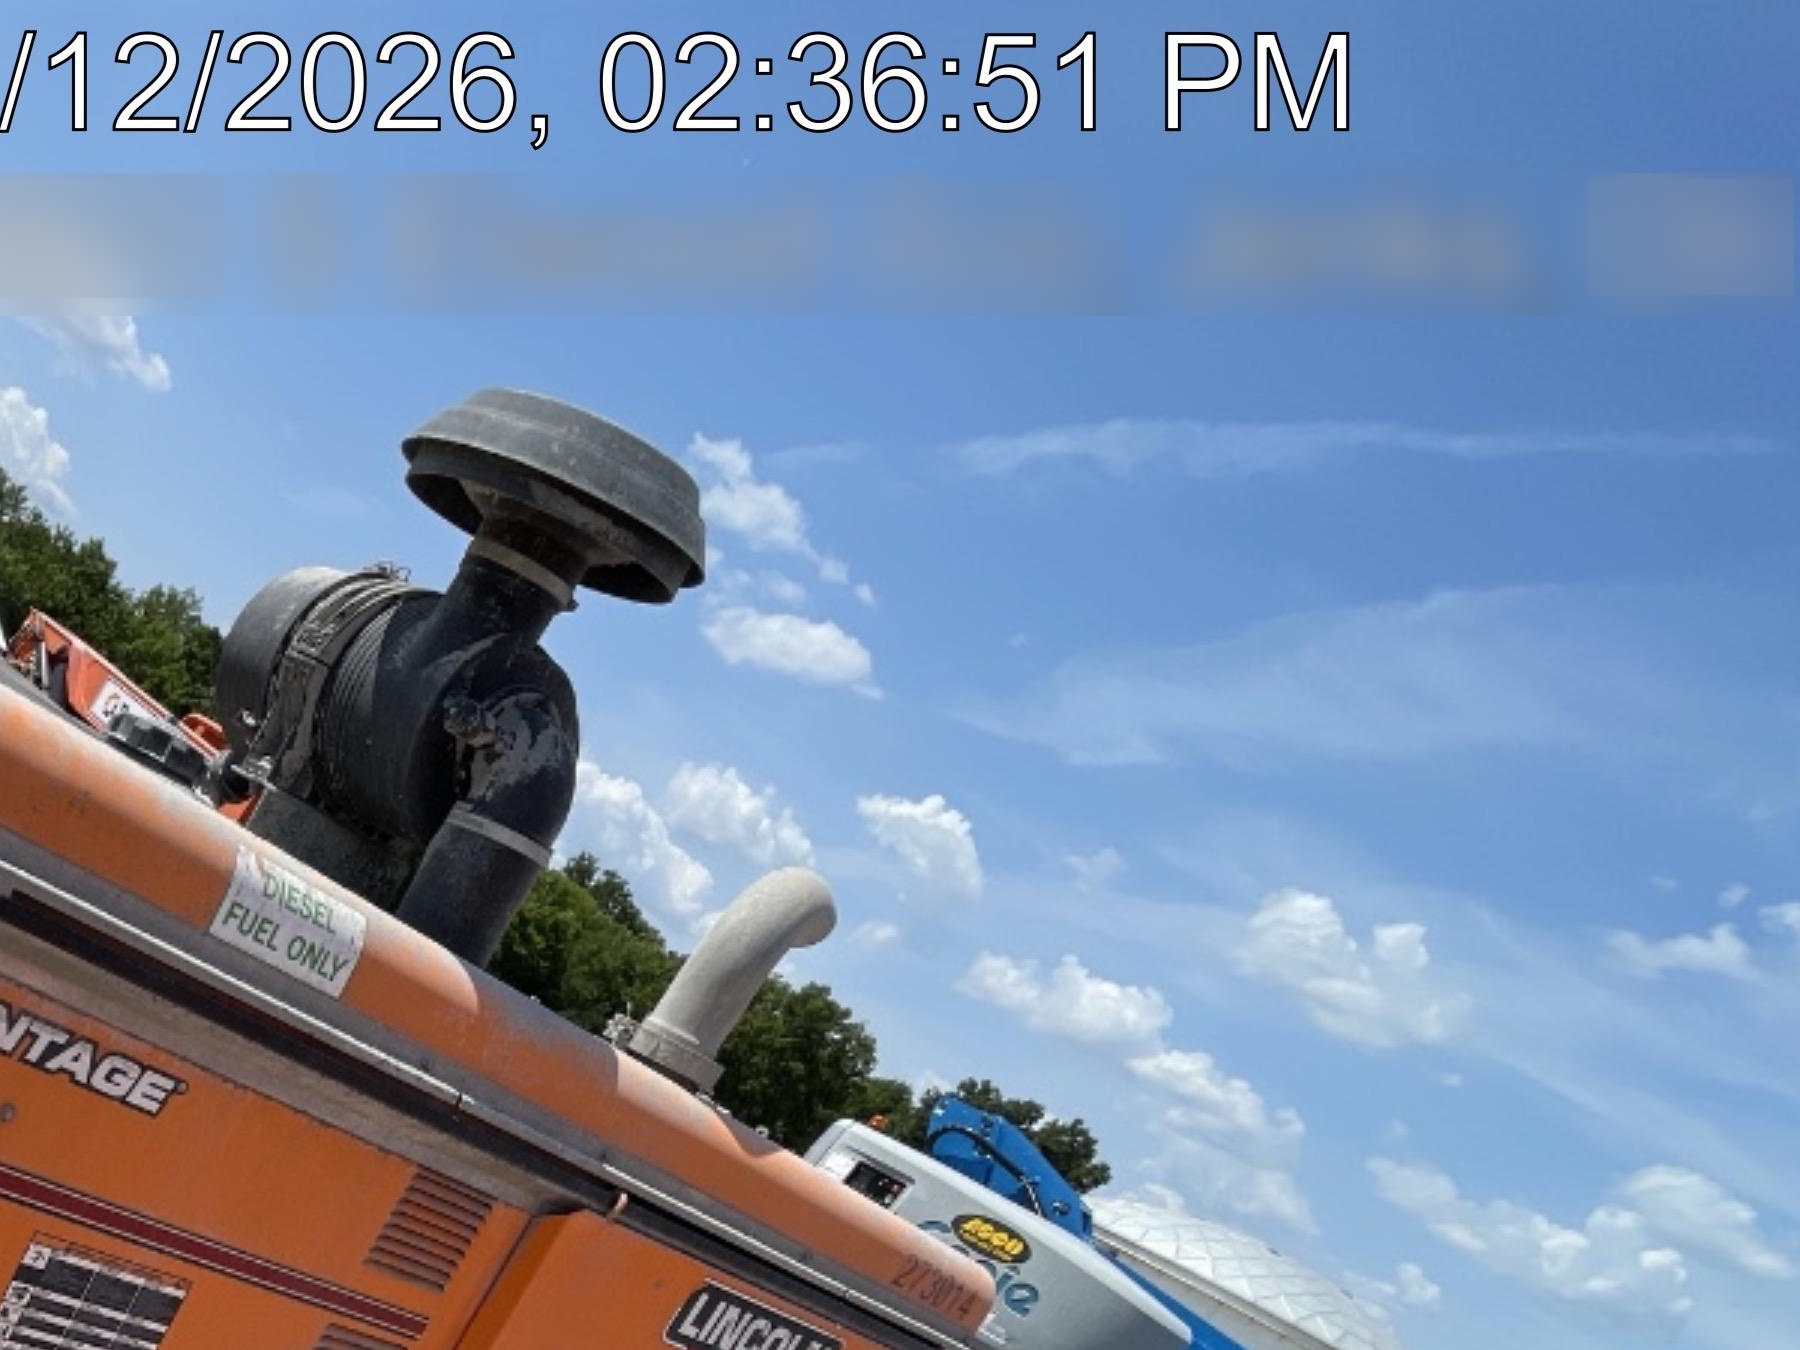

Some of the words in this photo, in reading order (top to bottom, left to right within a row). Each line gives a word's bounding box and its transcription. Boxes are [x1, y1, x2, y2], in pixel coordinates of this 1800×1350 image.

[263, 873, 336, 934] DIESEL
[222, 901, 280, 951] FUEL
[287, 935, 350, 982] ONLY
